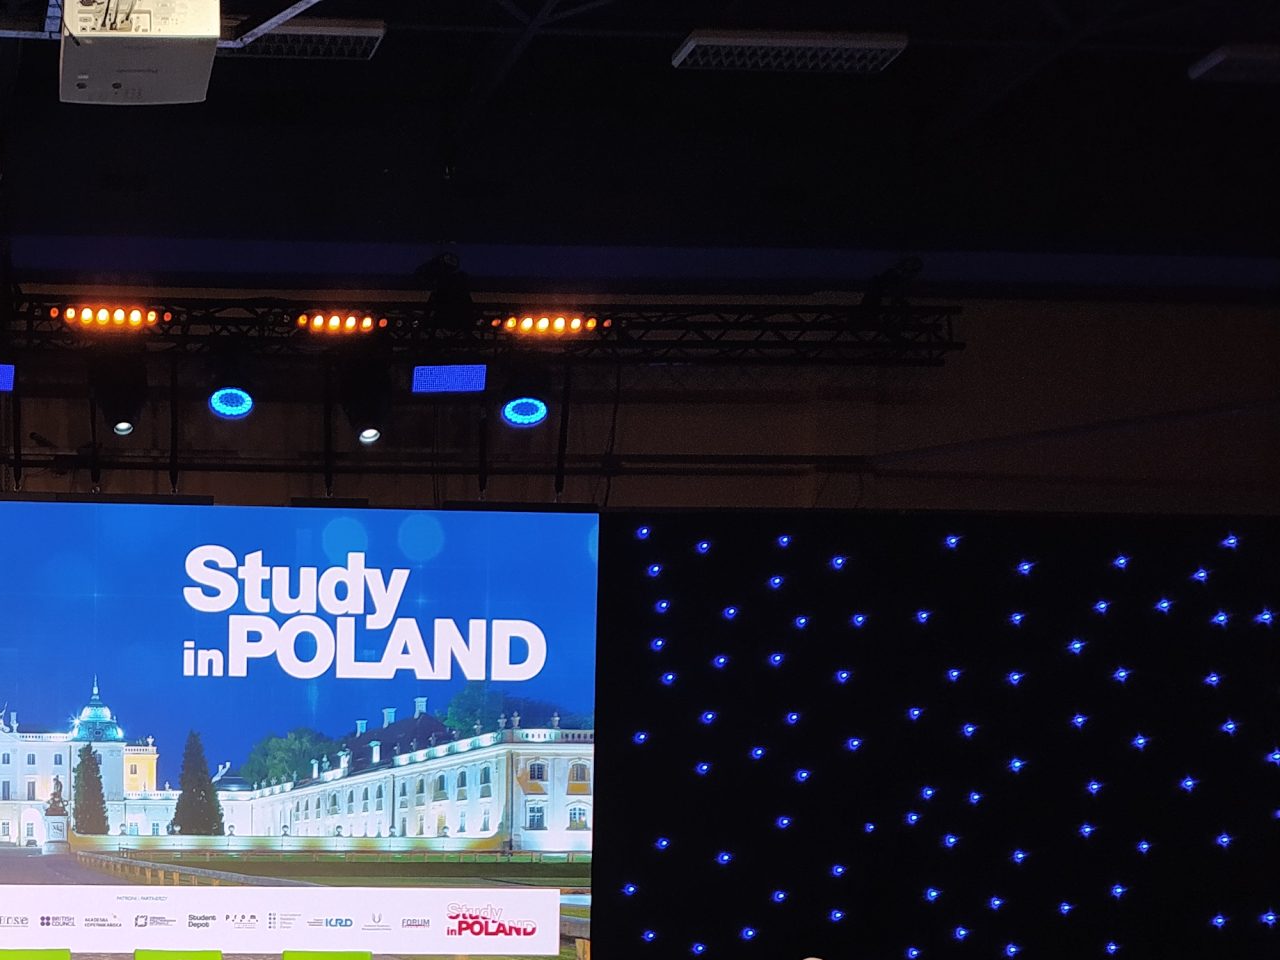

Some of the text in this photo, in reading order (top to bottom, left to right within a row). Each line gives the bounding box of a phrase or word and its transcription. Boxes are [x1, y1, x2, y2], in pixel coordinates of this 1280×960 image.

[183, 544, 410, 630] Study
[183, 614, 547, 681] in POLAND
[458, 919, 537, 936] POLAND
